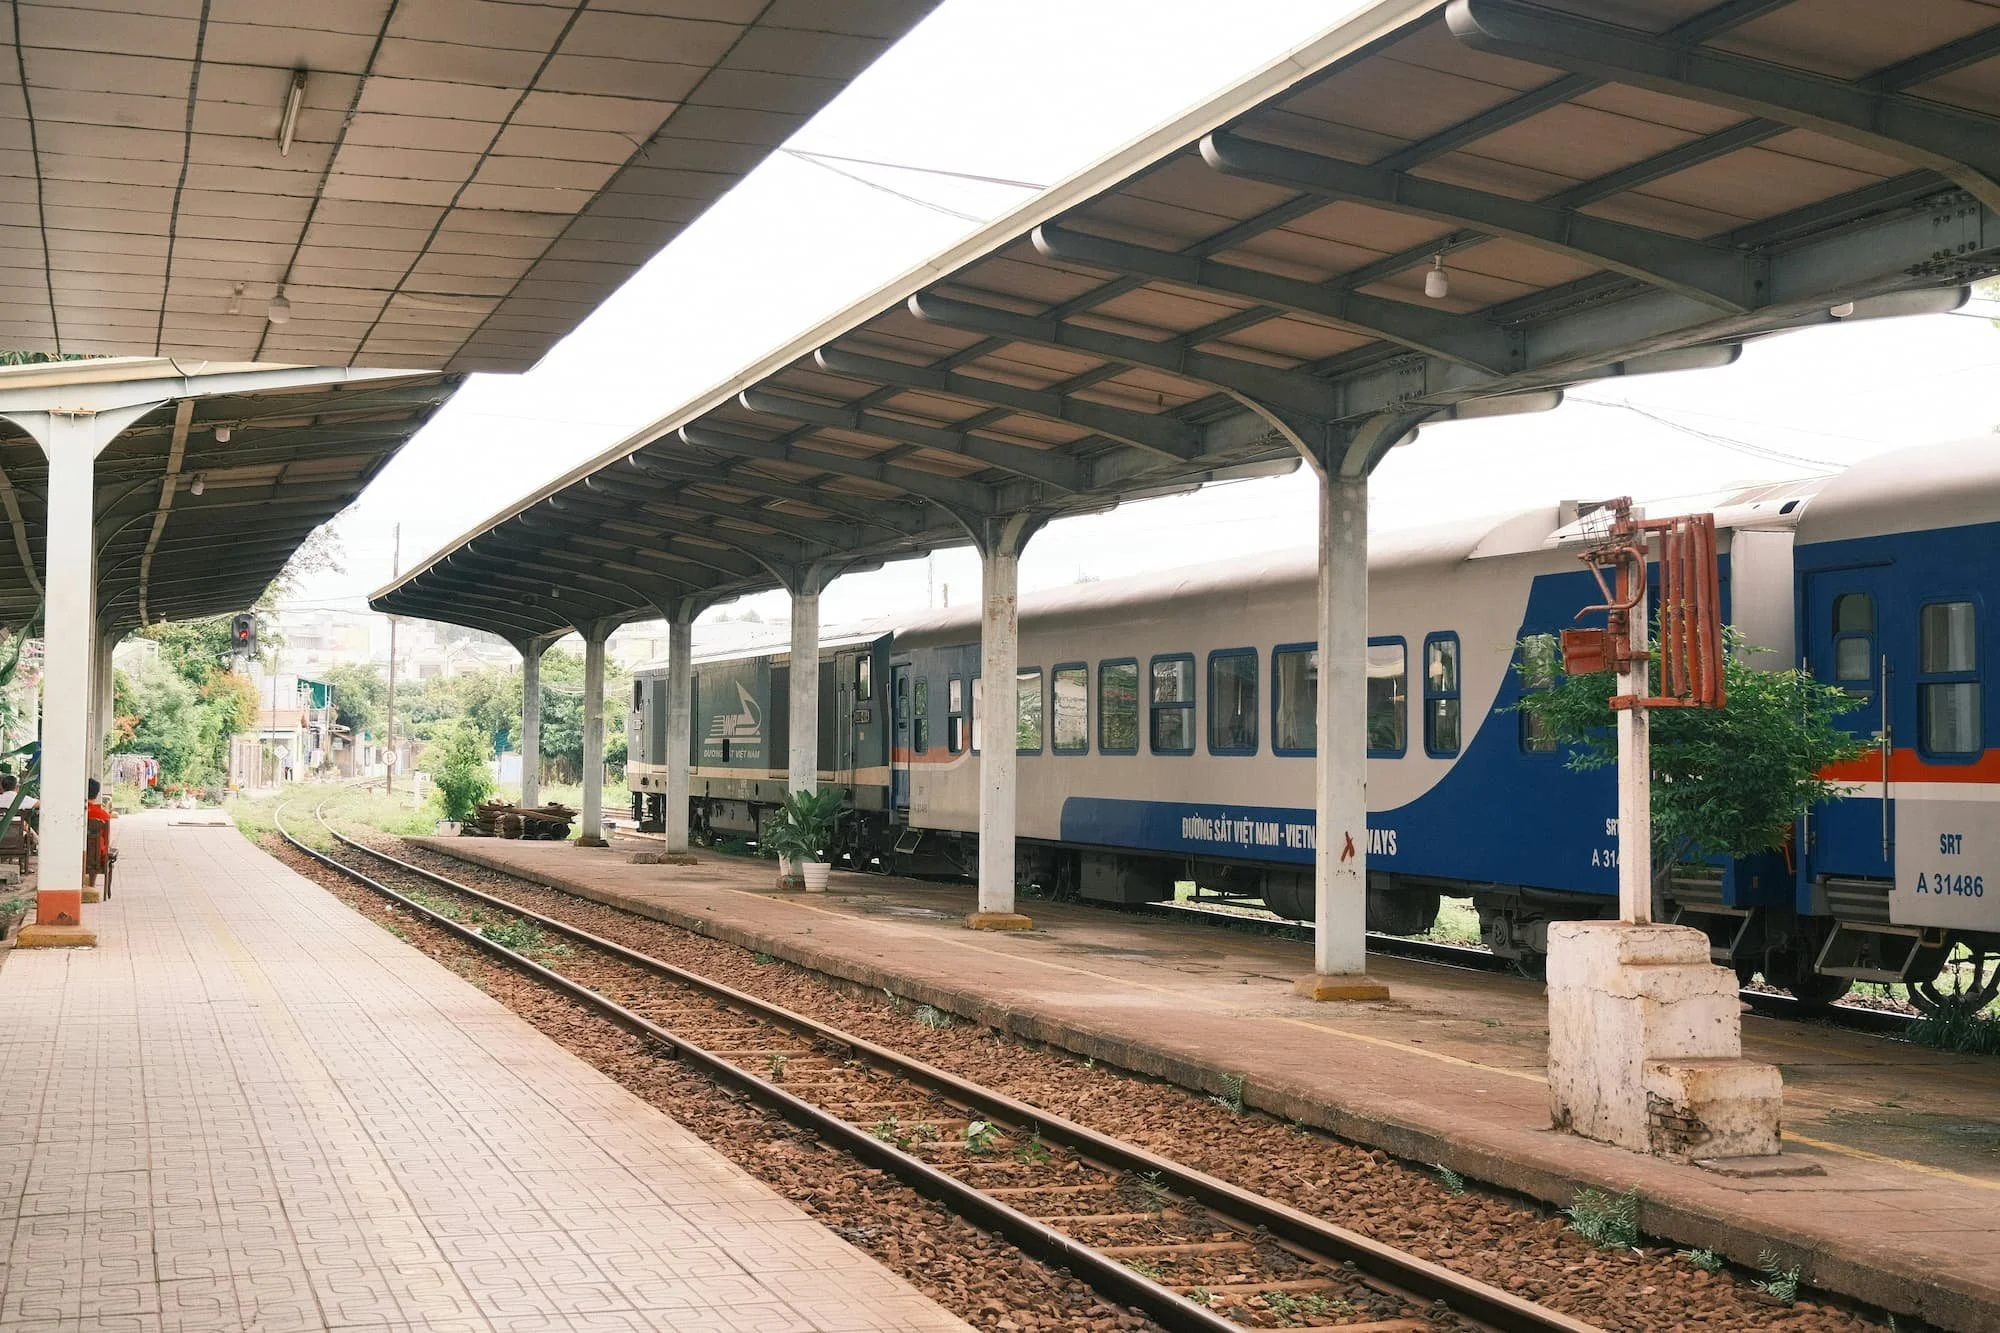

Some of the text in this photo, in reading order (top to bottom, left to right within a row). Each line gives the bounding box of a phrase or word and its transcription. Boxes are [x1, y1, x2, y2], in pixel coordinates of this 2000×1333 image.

[1214, 812, 1232, 842] SẮT
[1233, 816, 1254, 848] VIỆT
[1255, 822, 1279, 846] NAM
[1940, 833, 1962, 855] SRT
[1592, 849, 1600, 867] A
[1916, 872, 1984, 898] A 31486
